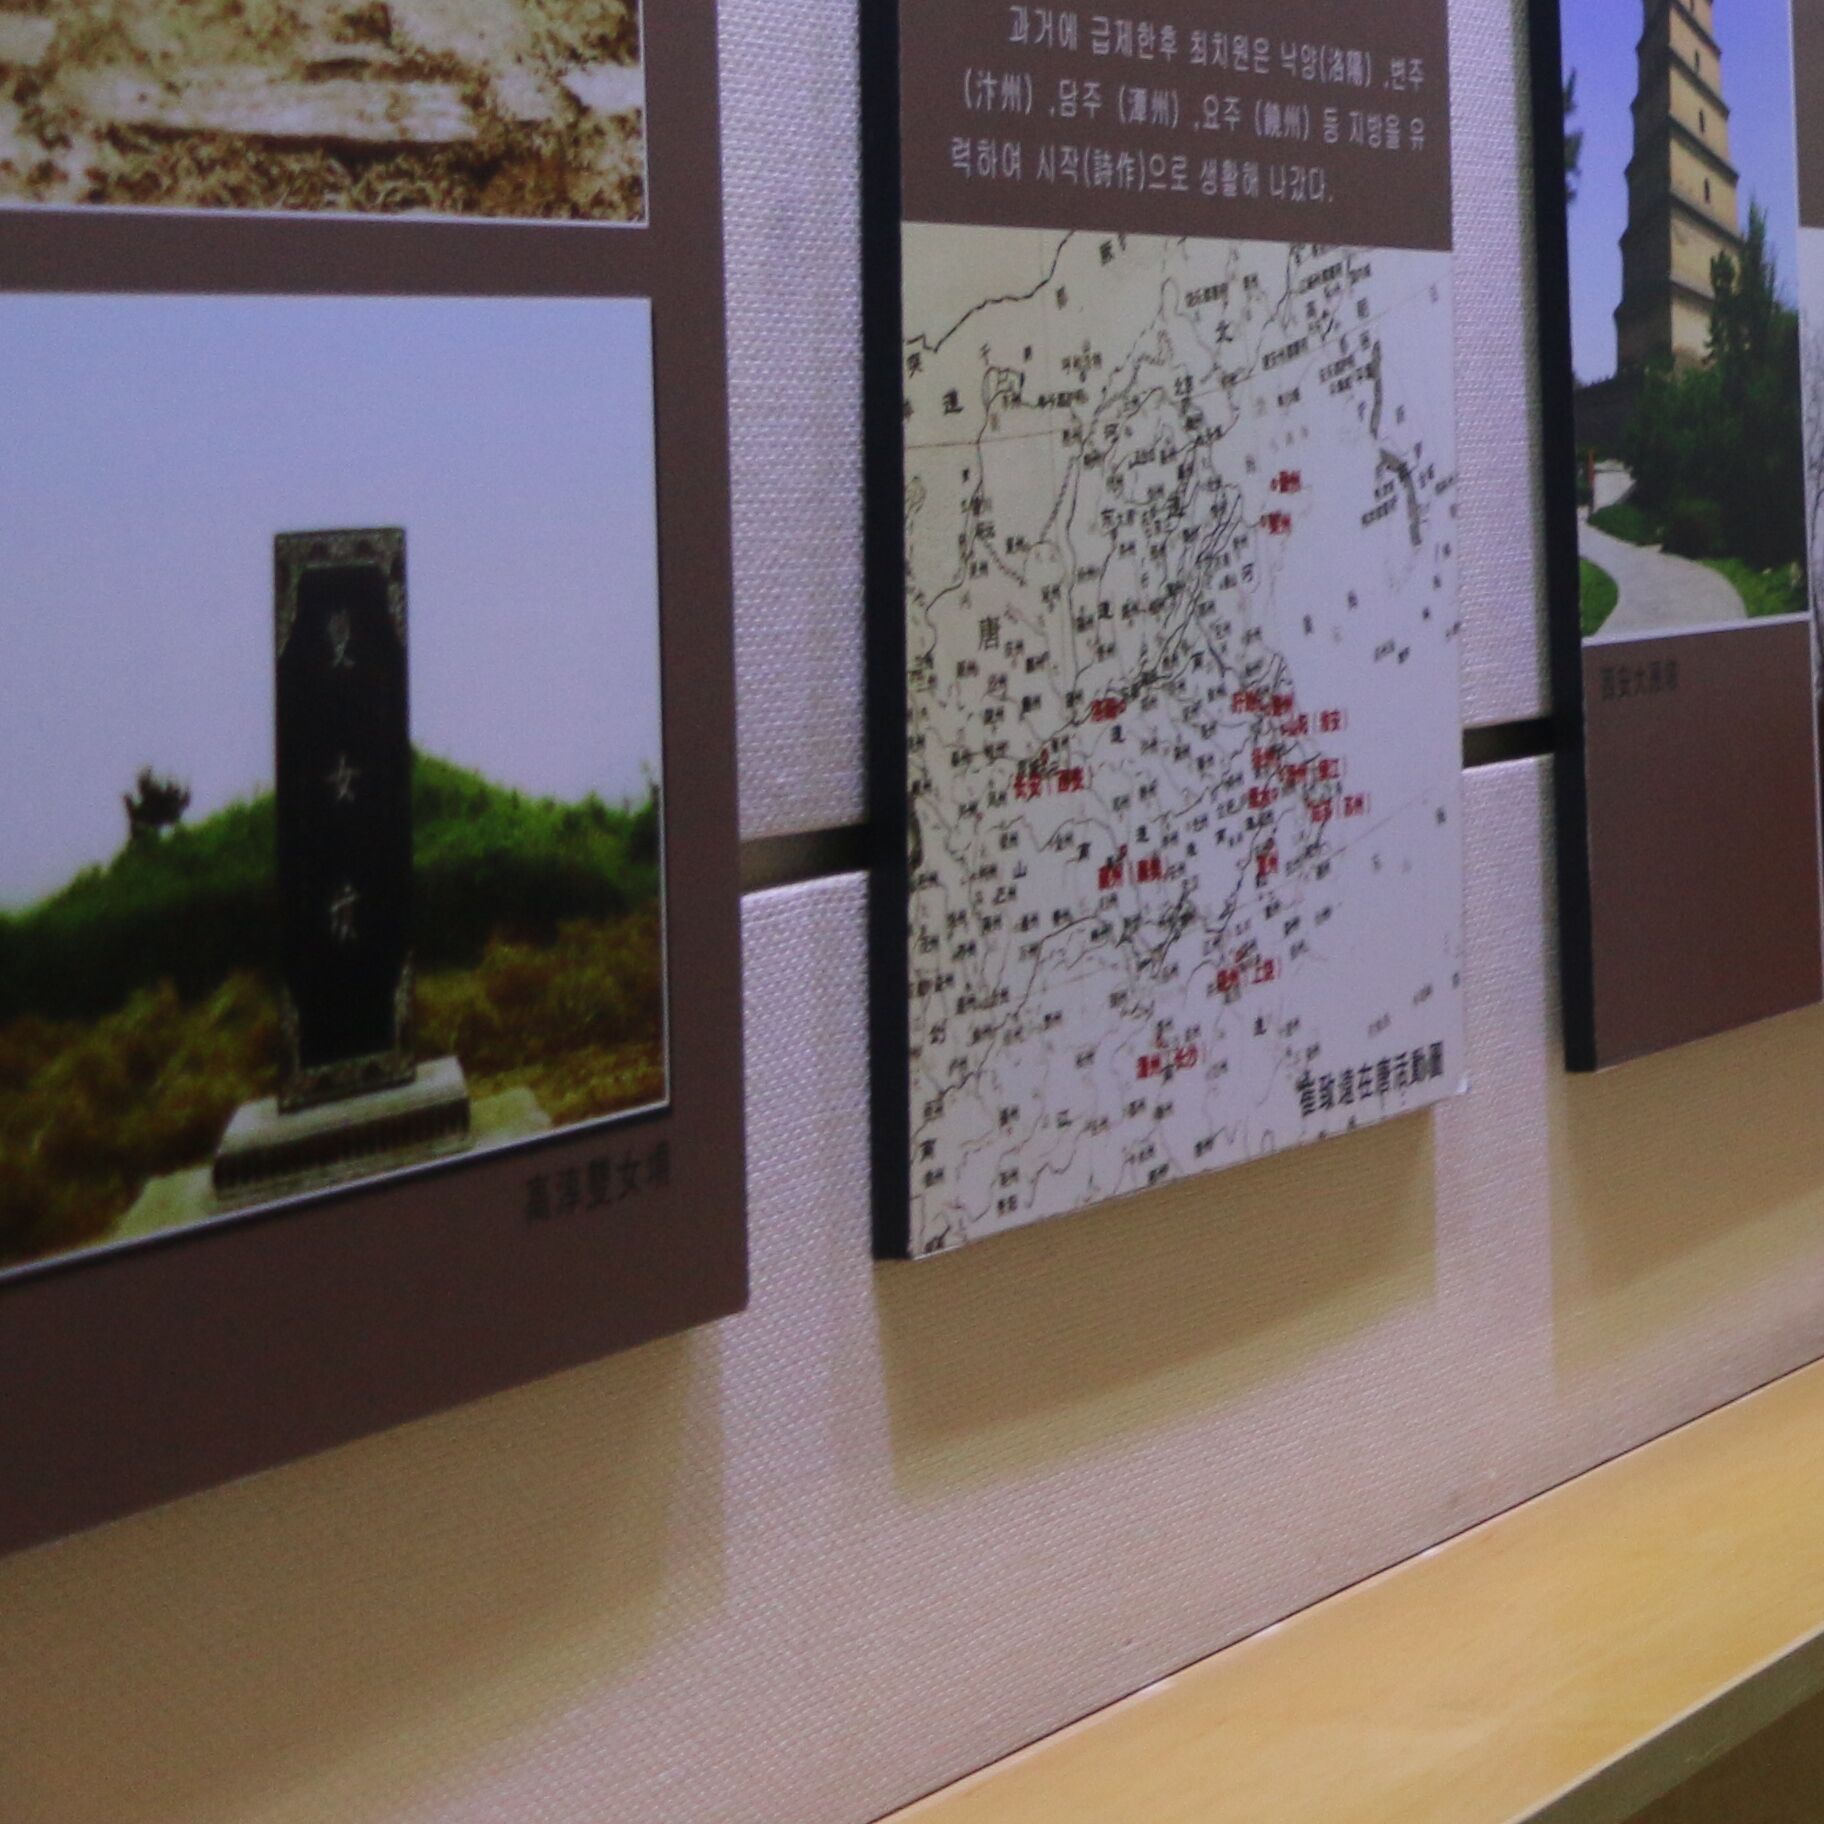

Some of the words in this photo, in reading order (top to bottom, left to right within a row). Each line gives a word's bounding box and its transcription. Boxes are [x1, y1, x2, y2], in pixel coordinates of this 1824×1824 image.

[1009, 5, 1078, 50] 과거에
[1091, 16, 1178, 61] 급제한후
[1190, 30, 1270, 74] 최치원은
[1323, 106, 1339, 144] 등
[1349, 111, 1401, 150] 지방을
[1410, 117, 1425, 151] 유
[951, 136, 1022, 181] 력하여
[1200, 158, 1259, 198] 생활해
[1270, 165, 1334, 202] 나갔다.
